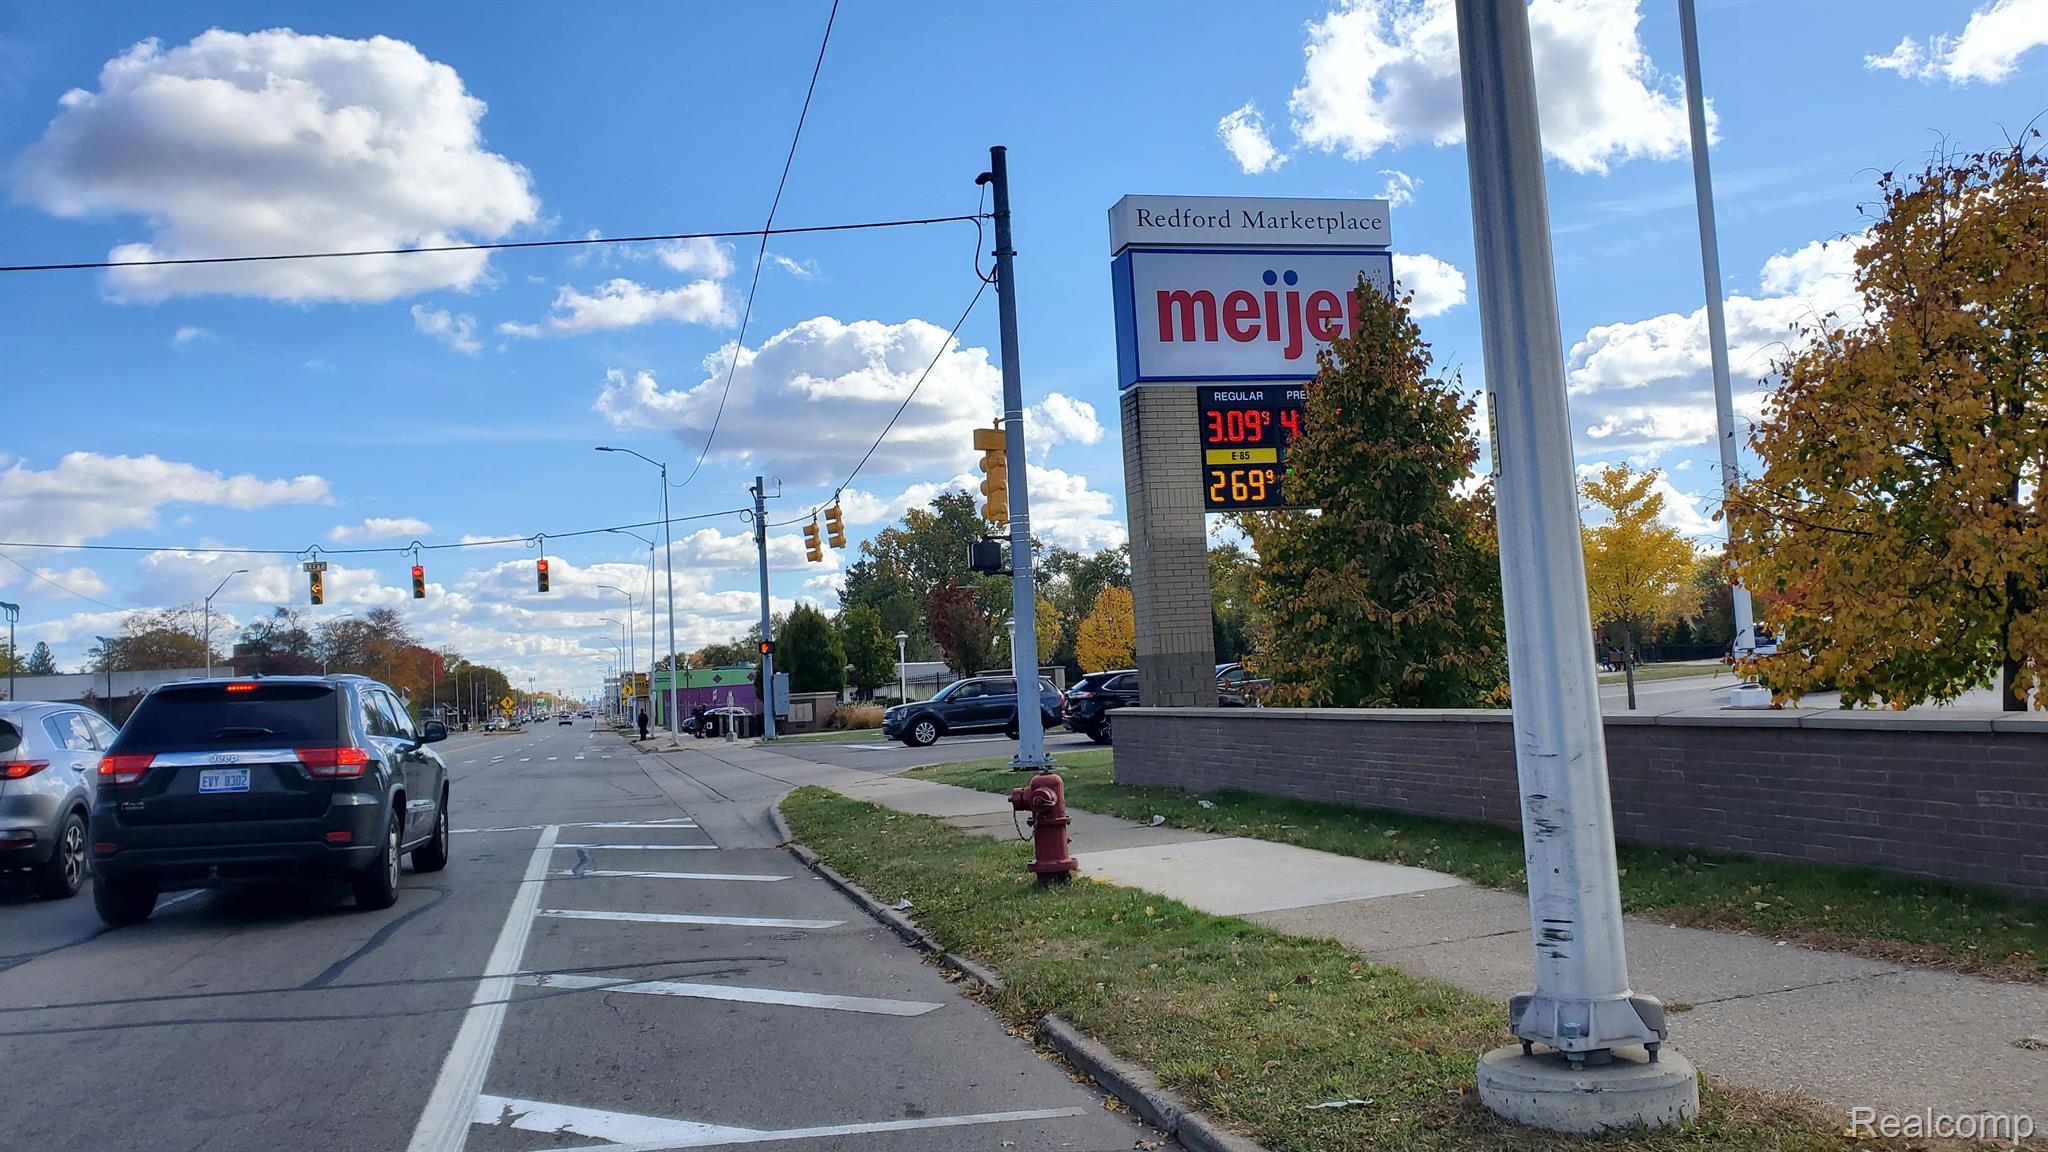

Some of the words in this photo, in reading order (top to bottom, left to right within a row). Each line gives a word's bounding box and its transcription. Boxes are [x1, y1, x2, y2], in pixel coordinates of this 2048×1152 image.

[1136, 208, 1232, 229] Redford
[1241, 210, 1382, 234] Marketplace
[1214, 391, 1264, 401] REGULAR
[1286, 390, 1308, 400] PRE
[1231, 451, 1250, 460] E-85
[209, 753, 239, 764] Jeep
[202, 775, 220, 787] EVY
